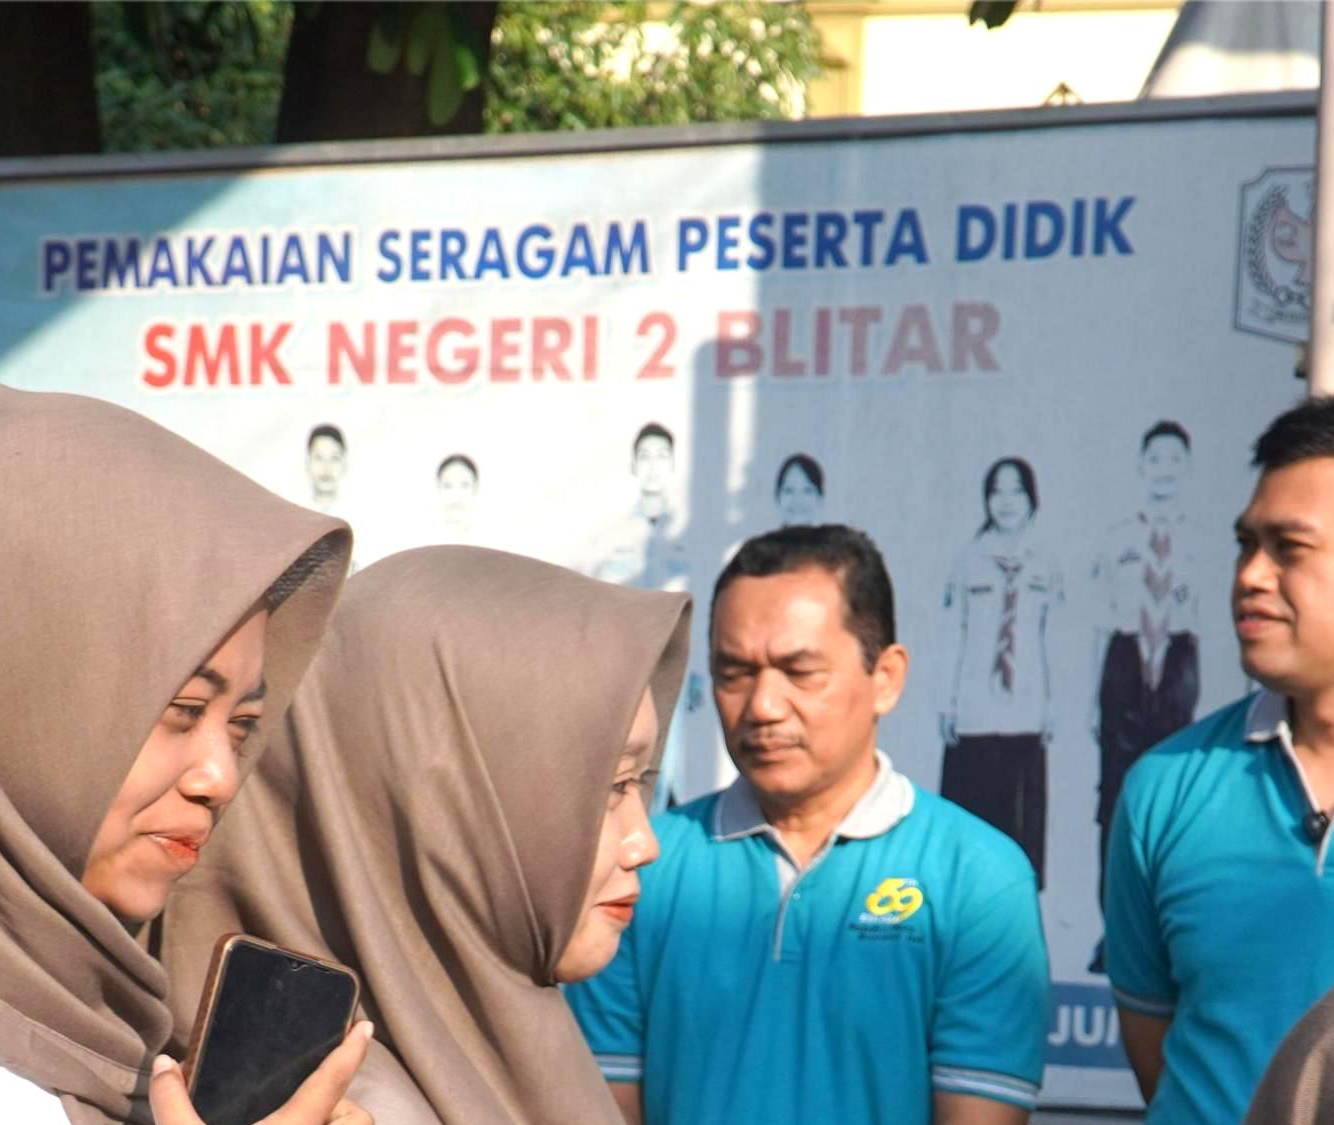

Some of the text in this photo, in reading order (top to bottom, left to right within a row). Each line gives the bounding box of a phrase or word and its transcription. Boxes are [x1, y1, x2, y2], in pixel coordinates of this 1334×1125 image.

[42, 197, 1137, 293] PEMAKAIAN SERAGAM PESERTA DIDIK
[142, 302, 1003, 389] SMK NEGERI 2 BLITAR
